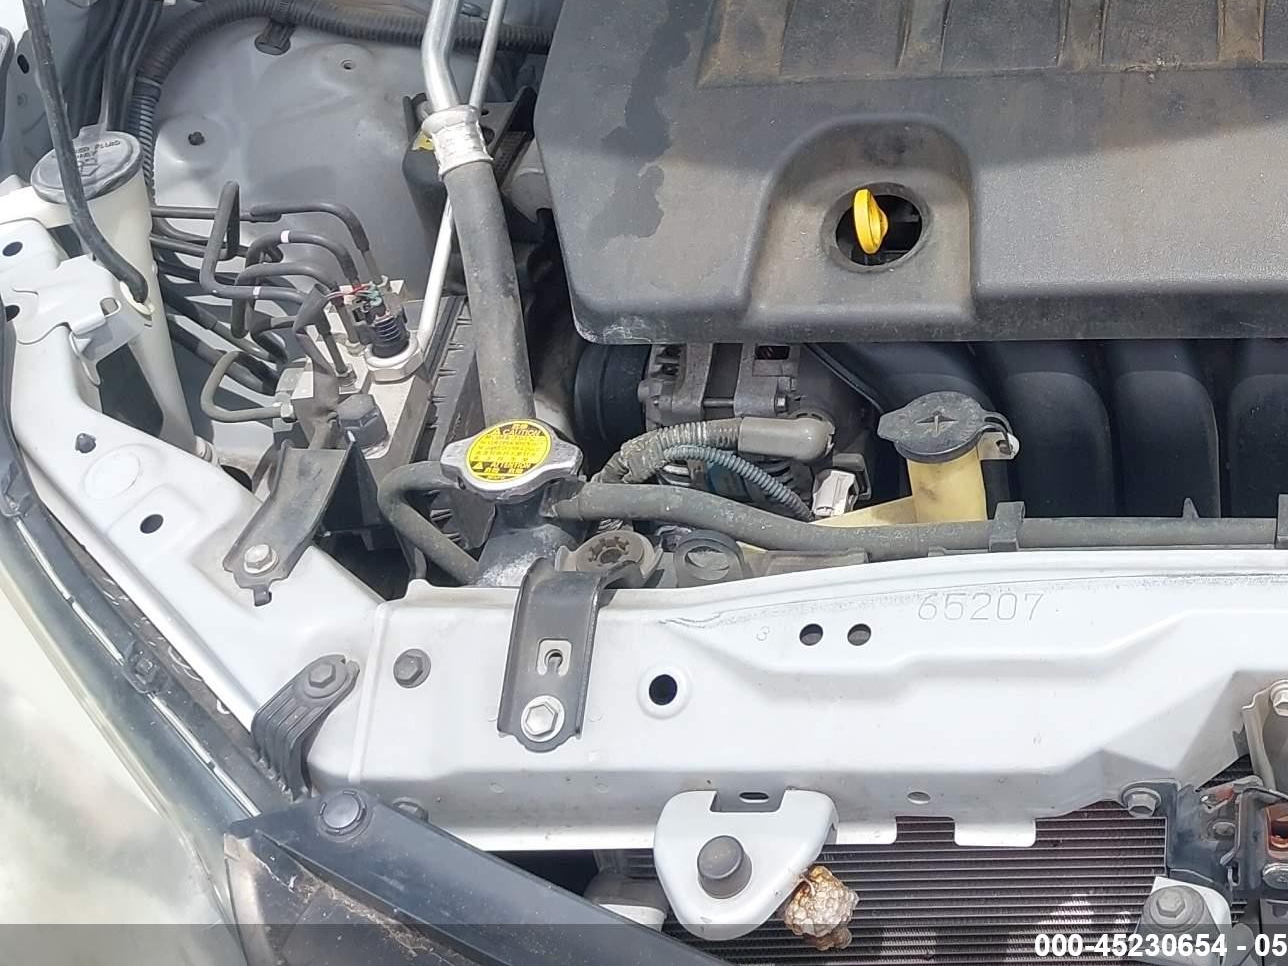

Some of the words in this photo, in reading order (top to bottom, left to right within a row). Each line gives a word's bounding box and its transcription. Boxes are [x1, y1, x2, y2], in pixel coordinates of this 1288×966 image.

[502, 428, 541, 436] CAUTION
[490, 461, 532, 469] ATTENTION
[917, 593, 1046, 622] 65207
